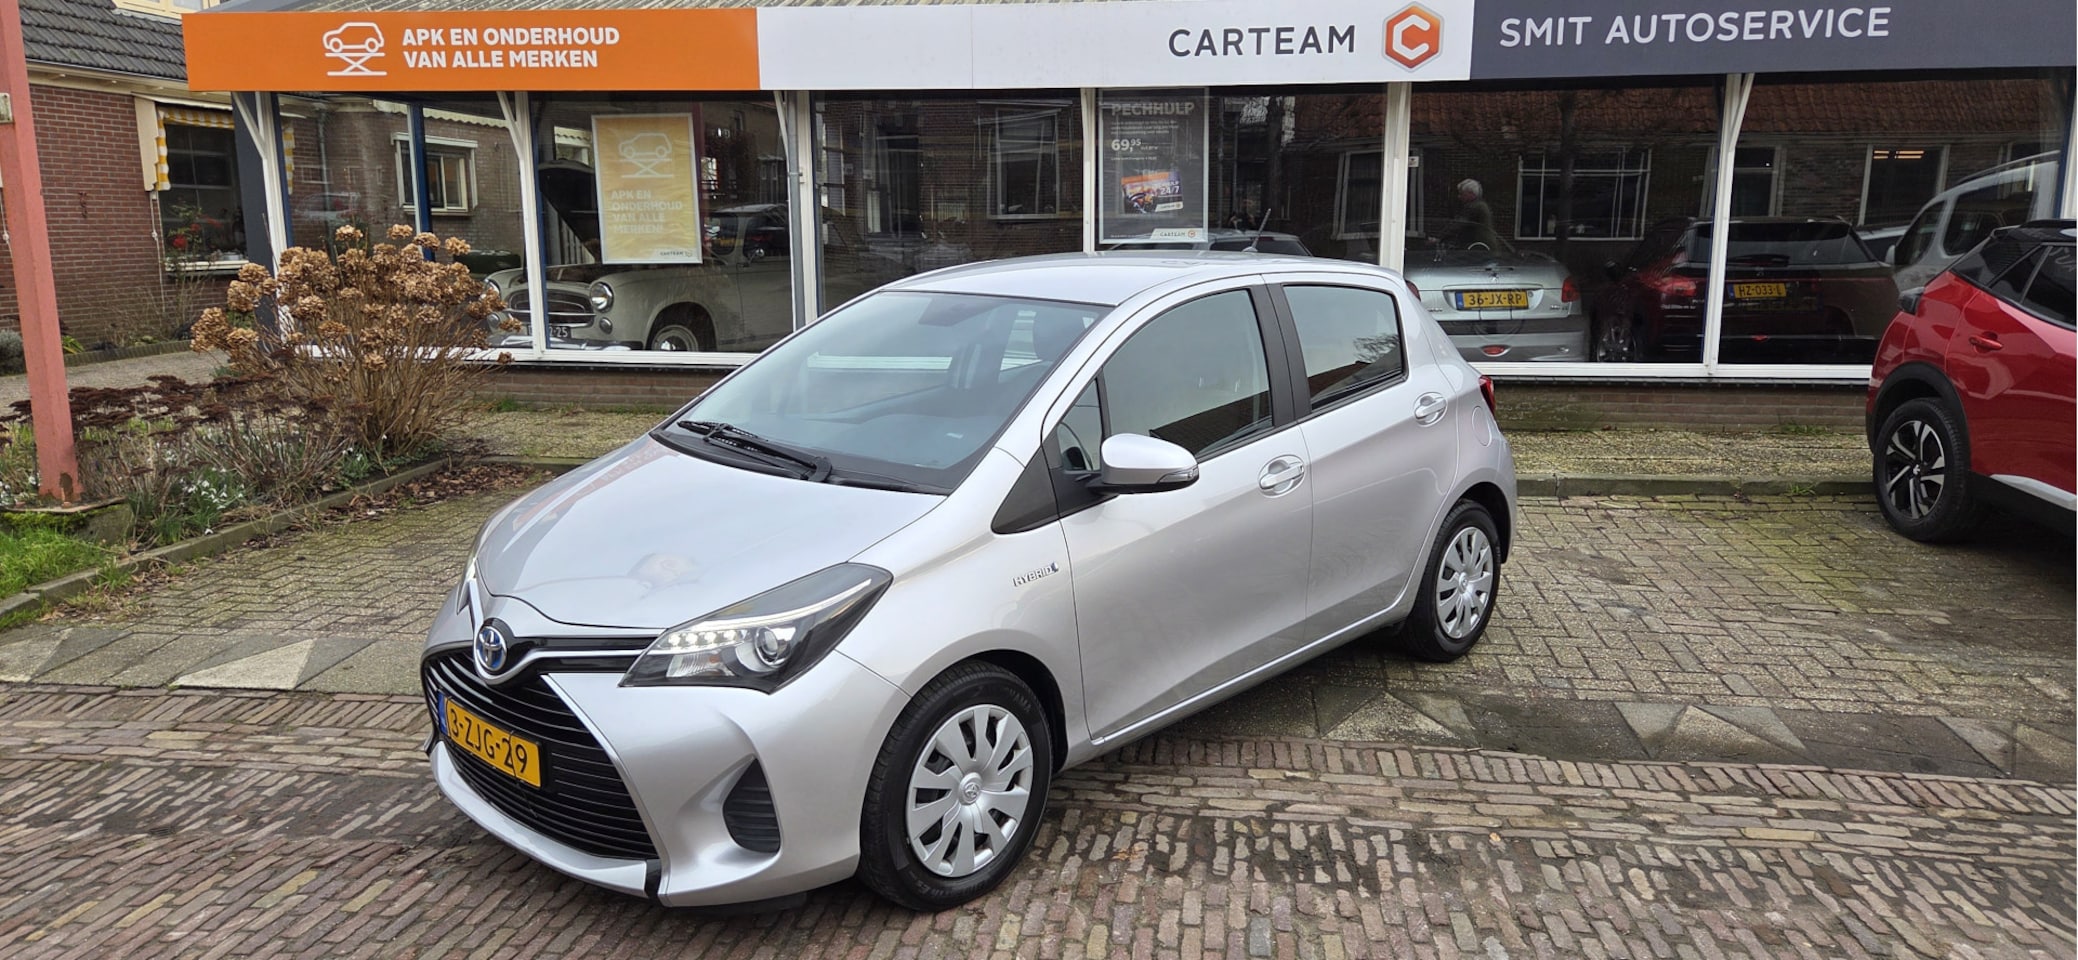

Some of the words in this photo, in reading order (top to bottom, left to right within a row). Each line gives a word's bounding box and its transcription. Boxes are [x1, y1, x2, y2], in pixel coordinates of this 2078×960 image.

[402, 28, 446, 46] APK
[450, 28, 478, 46] EN
[483, 27, 620, 46] ONDERHOUD
[1499, 16, 1593, 48] SMIT
[1605, 7, 1892, 45] AUTOSERVICE
[1168, 25, 1356, 57] CARTEAM
[403, 51, 447, 68] VAN
[452, 50, 504, 67] ALLE
[509, 50, 598, 67] MERKEN
[1111, 102, 1195, 116] PECHHULP
[611, 189, 634, 200] APK
[637, 189, 652, 200] EN
[611, 201, 684, 212] ONDERHOUD
[612, 212, 636, 223] VAN
[639, 212, 665, 222] ALLE
[1468, 293, 1523, 306] 36-JX-RP
[1012, 566, 1051, 587] HYBRID
[450, 708, 528, 774] 3-ZJG-29
